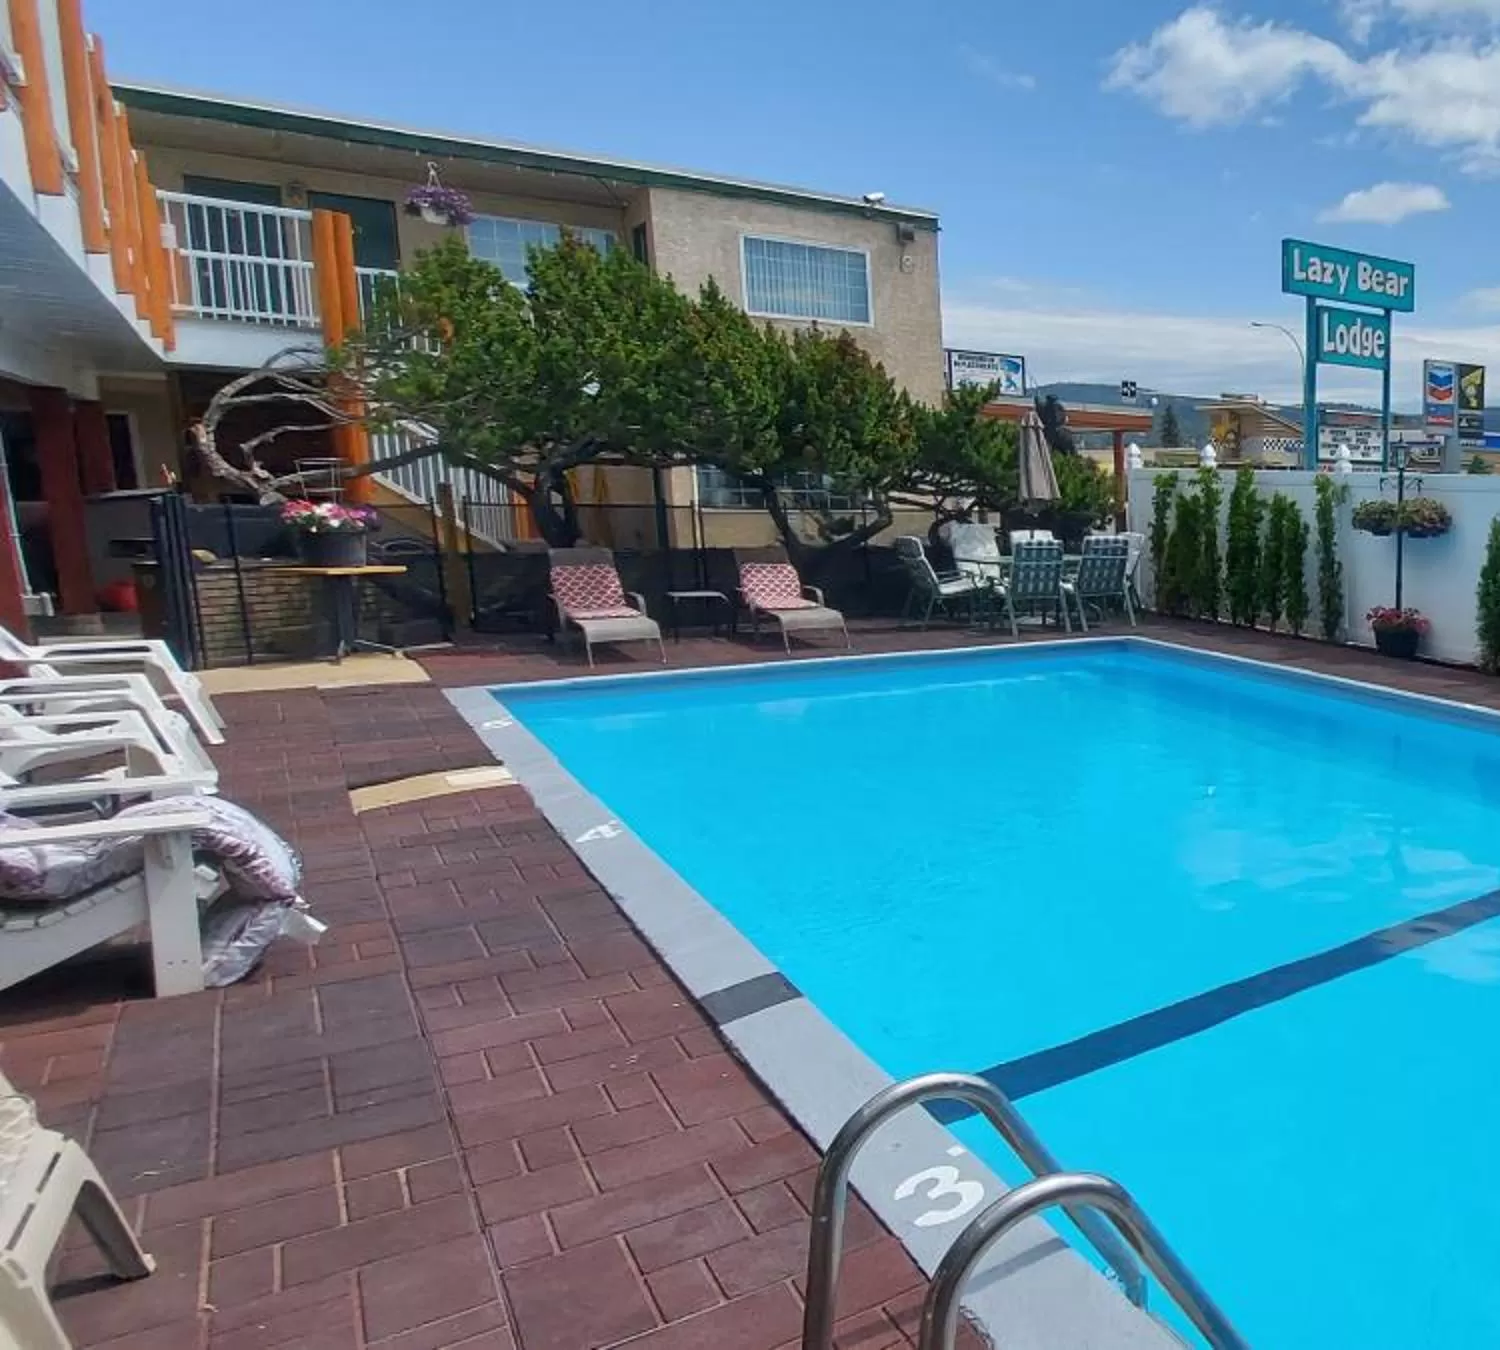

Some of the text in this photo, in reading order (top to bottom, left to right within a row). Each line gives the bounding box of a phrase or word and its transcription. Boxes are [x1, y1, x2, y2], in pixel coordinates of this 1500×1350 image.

[1293, 247, 1409, 297] Lazy Bear
[1323, 311, 1385, 359] Lodge
